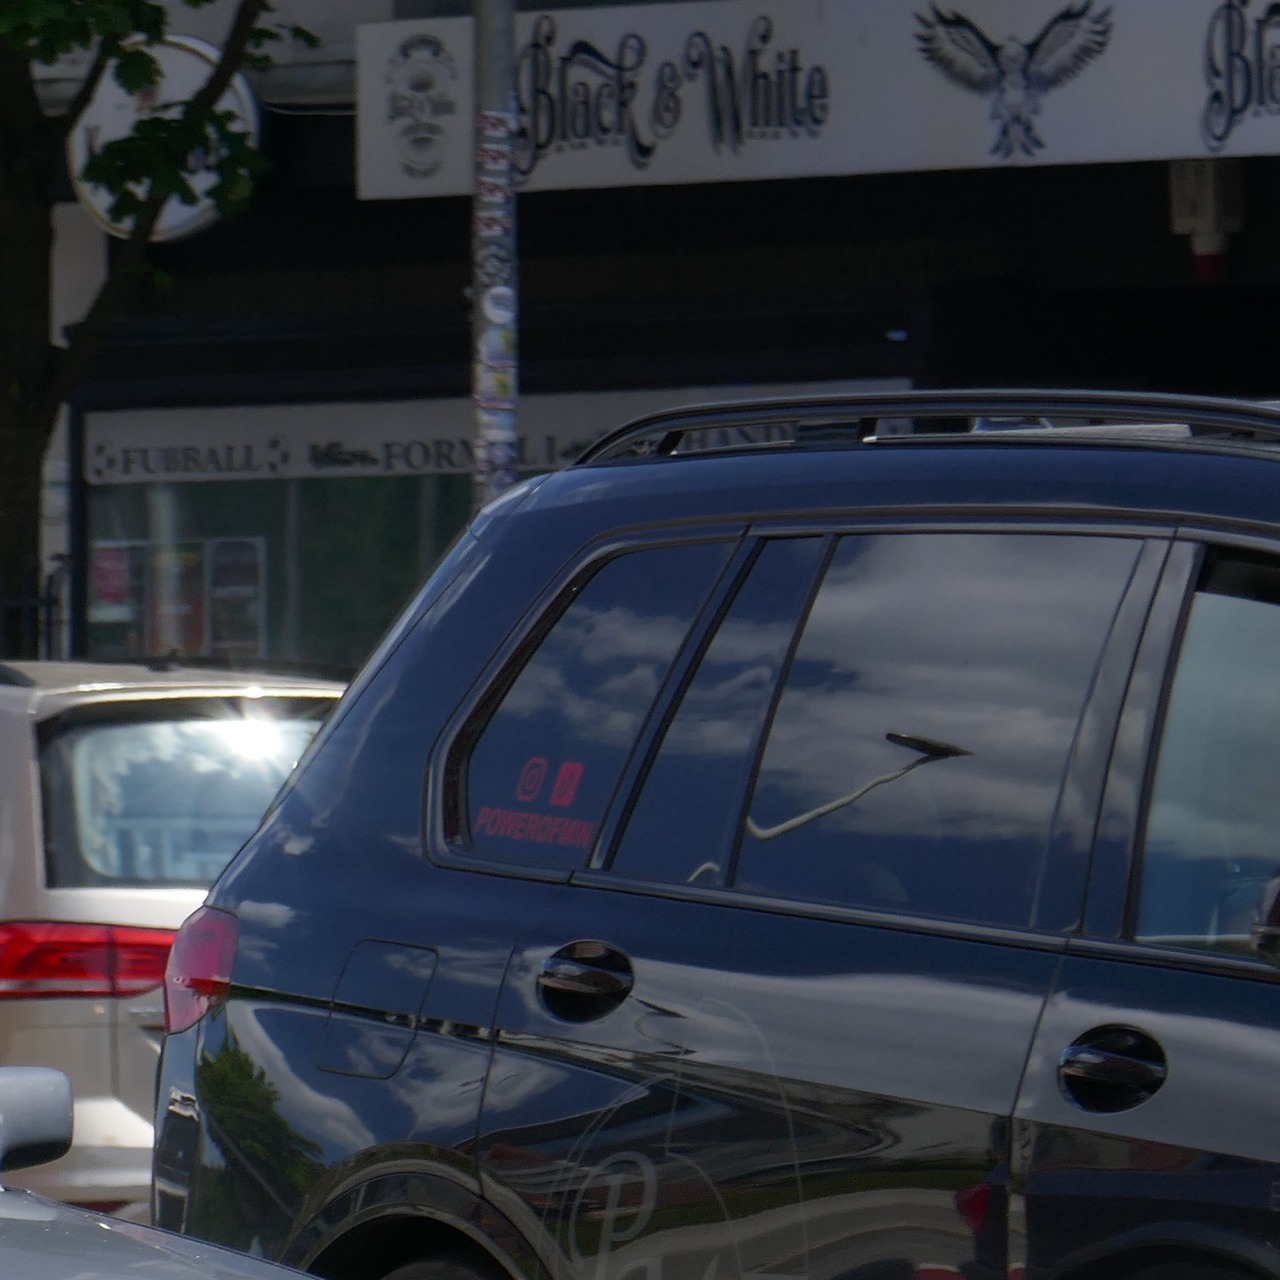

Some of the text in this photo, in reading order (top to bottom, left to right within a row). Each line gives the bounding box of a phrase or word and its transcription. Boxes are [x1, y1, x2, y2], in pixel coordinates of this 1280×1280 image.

[513, 13, 656, 184] Black
[684, 15, 832, 156] White
[1202, 0, 1280, 151] Bla
[383, 435, 536, 472] FORL
